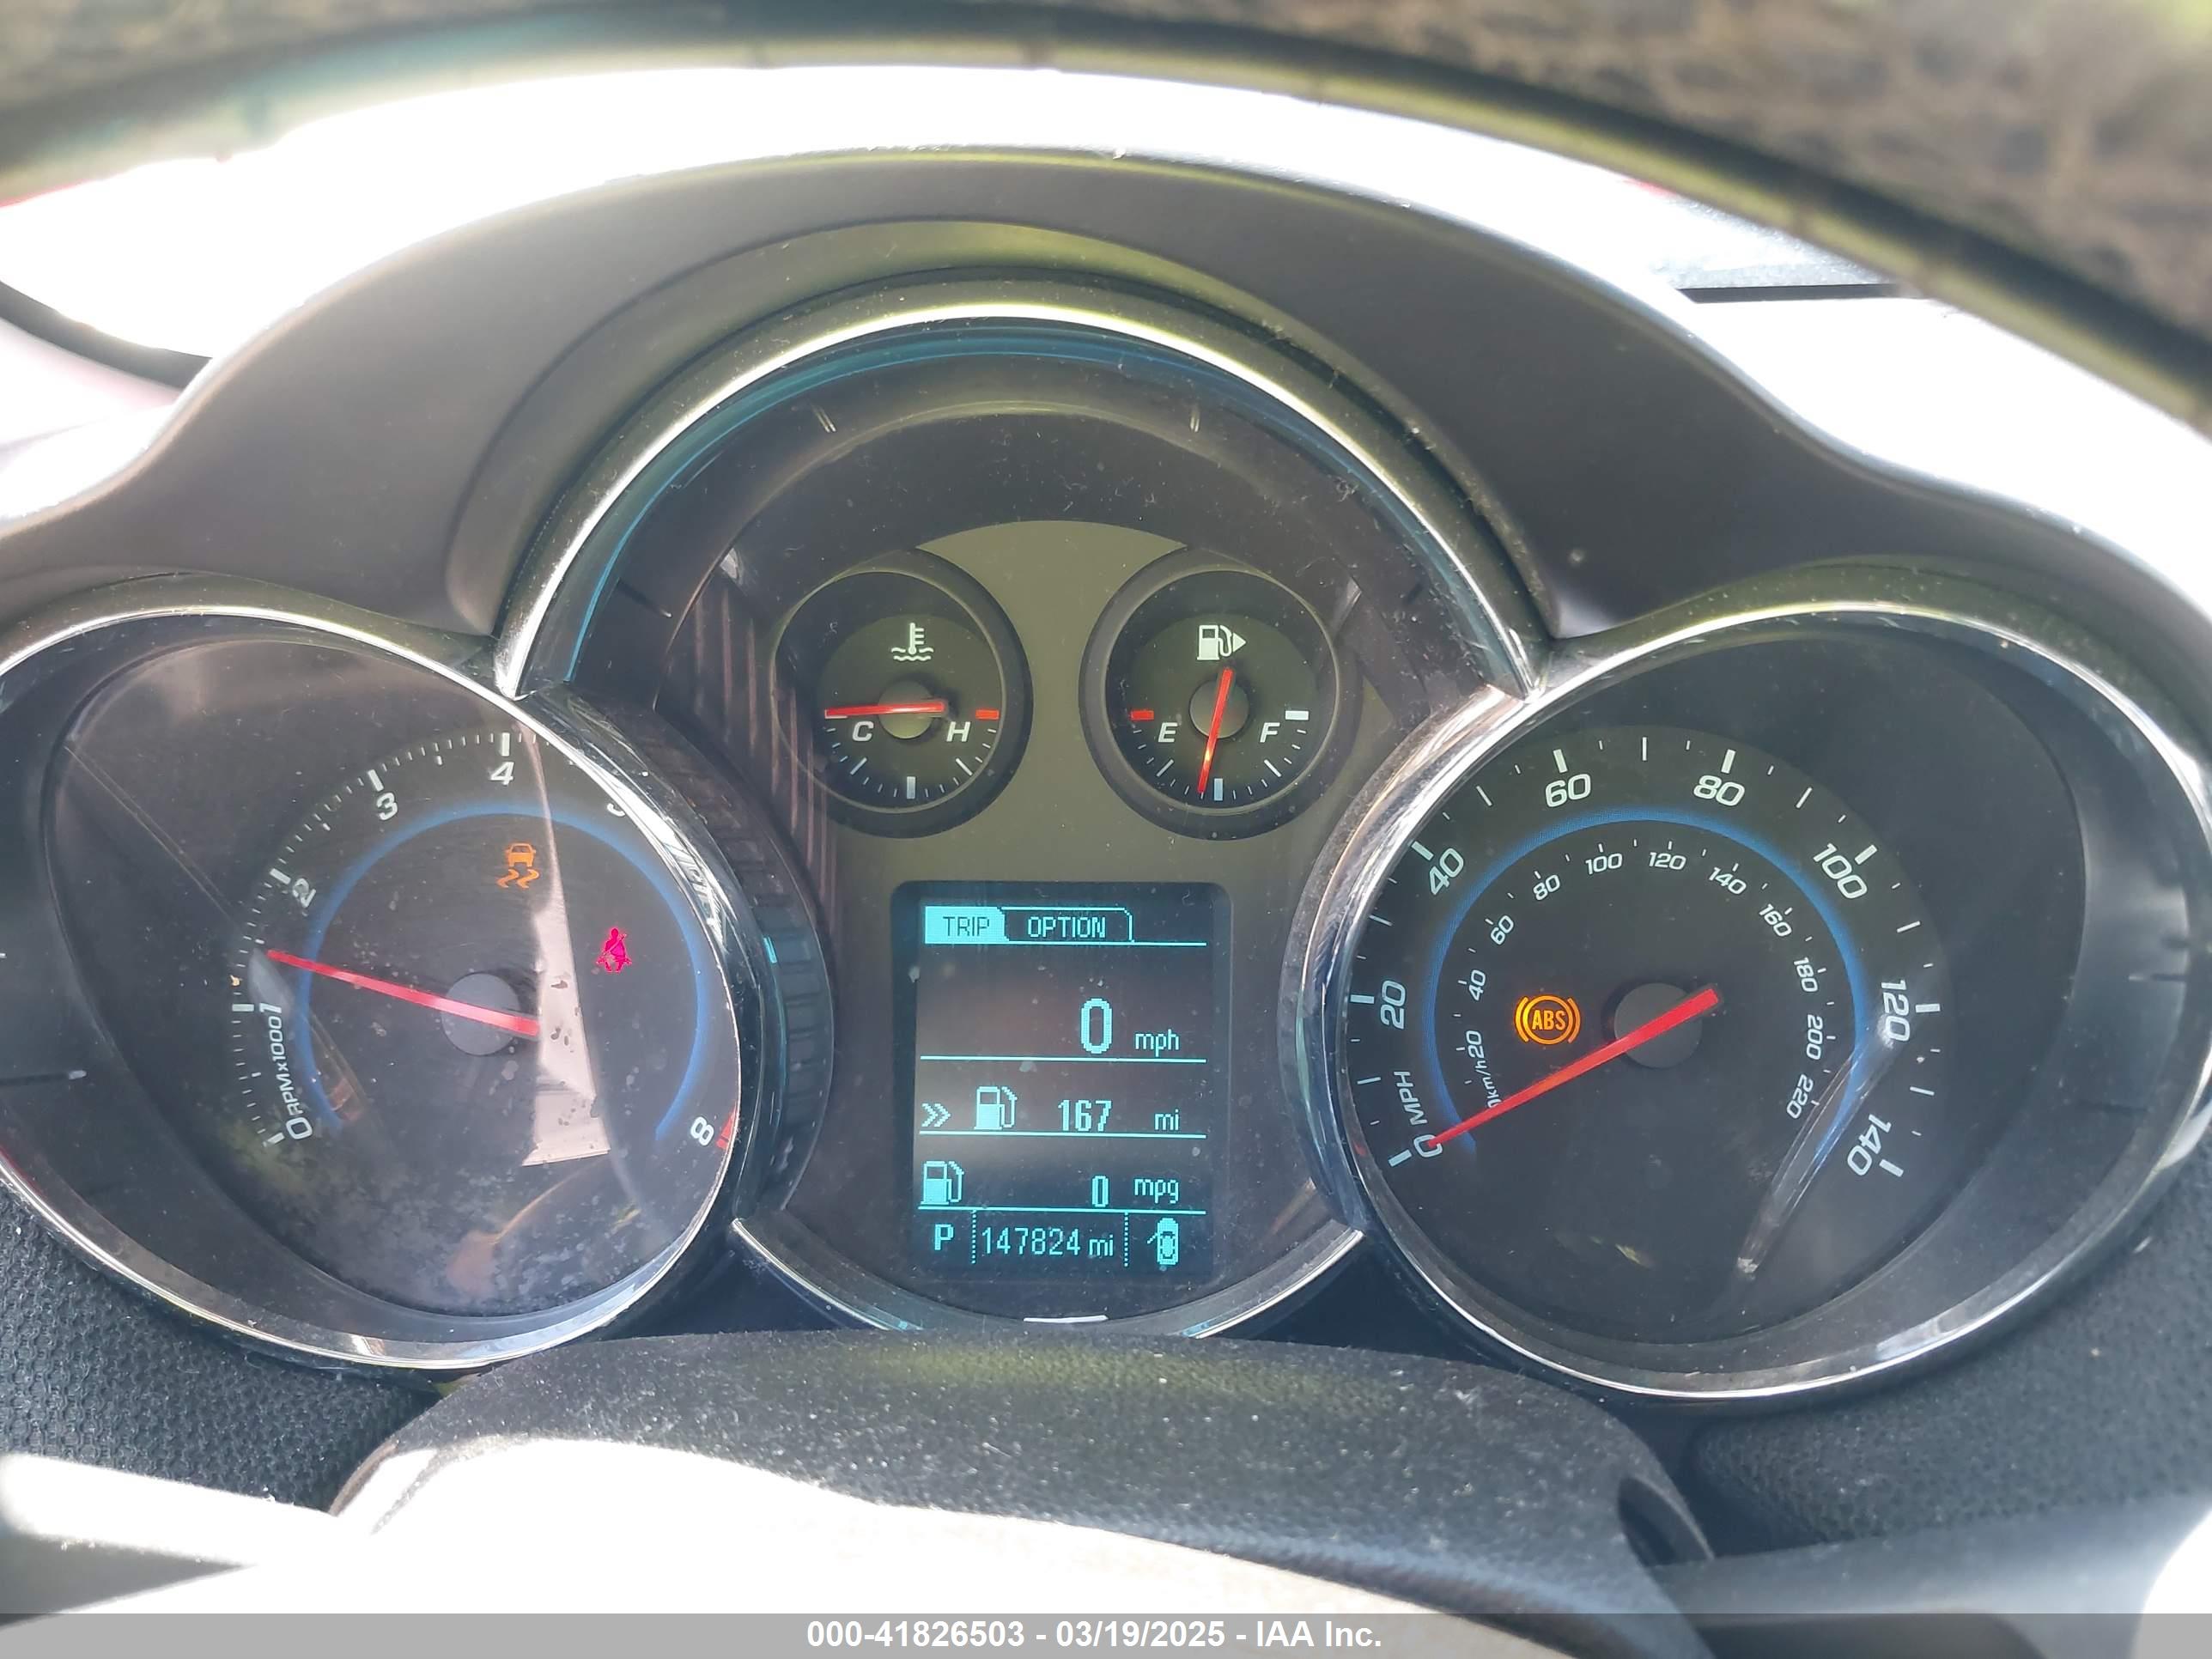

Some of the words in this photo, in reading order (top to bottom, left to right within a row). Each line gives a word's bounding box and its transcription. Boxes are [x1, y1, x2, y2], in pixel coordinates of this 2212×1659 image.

[853, 721, 874, 742] C
[946, 721, 971, 742] H
[1158, 722, 1178, 743] E
[1260, 722, 1281, 743] F
[490, 762, 514, 786] 4
[1545, 774, 1591, 806] 60
[1693, 773, 1745, 806] 80
[376, 792, 398, 821] 3
[1426, 847, 1464, 895] 40
[1585, 852, 1623, 875] 100
[1648, 851, 1686, 871] 120
[1813, 842, 1867, 899] 100
[292, 878, 317, 908] 2
[1533, 874, 1560, 901] 80
[1708, 866, 1747, 896] 140
[942, 915, 990, 937] TRIP
[1027, 916, 1107, 939] OPTION
[1490, 915, 1514, 945] 60
[1759, 903, 1793, 937] 160
[1468, 969, 1486, 1001] 40
[1793, 957, 1819, 993] 180
[1380, 980, 1407, 1030] 20
[1531, 1009, 1566, 1030] ABS
[1881, 979, 1911, 1042] 120
[1080, 998, 1113, 1054] 0
[1134, 1029, 1180, 1057] mph
[1806, 1013, 1824, 1060] 200
[1466, 1030, 1485, 1059] 20
[1394, 1071, 1428, 1126] MPH
[1786, 1073, 1814, 1119] 220
[285, 1116, 313, 1140] 0
[690, 1116, 714, 1146] 8
[1057, 1099, 1113, 1133] 167
[1154, 1109, 1179, 1131] mi
[1413, 1133, 1443, 1158] 0
[1846, 1114, 1892, 1176] 140
[1091, 1175, 1109, 1207] 0
[1134, 1178, 1179, 1204] mpg
[934, 1224, 954, 1251] P
[981, 1227, 1080, 1255] 147824
[1088, 1234, 1114, 1257] mi
